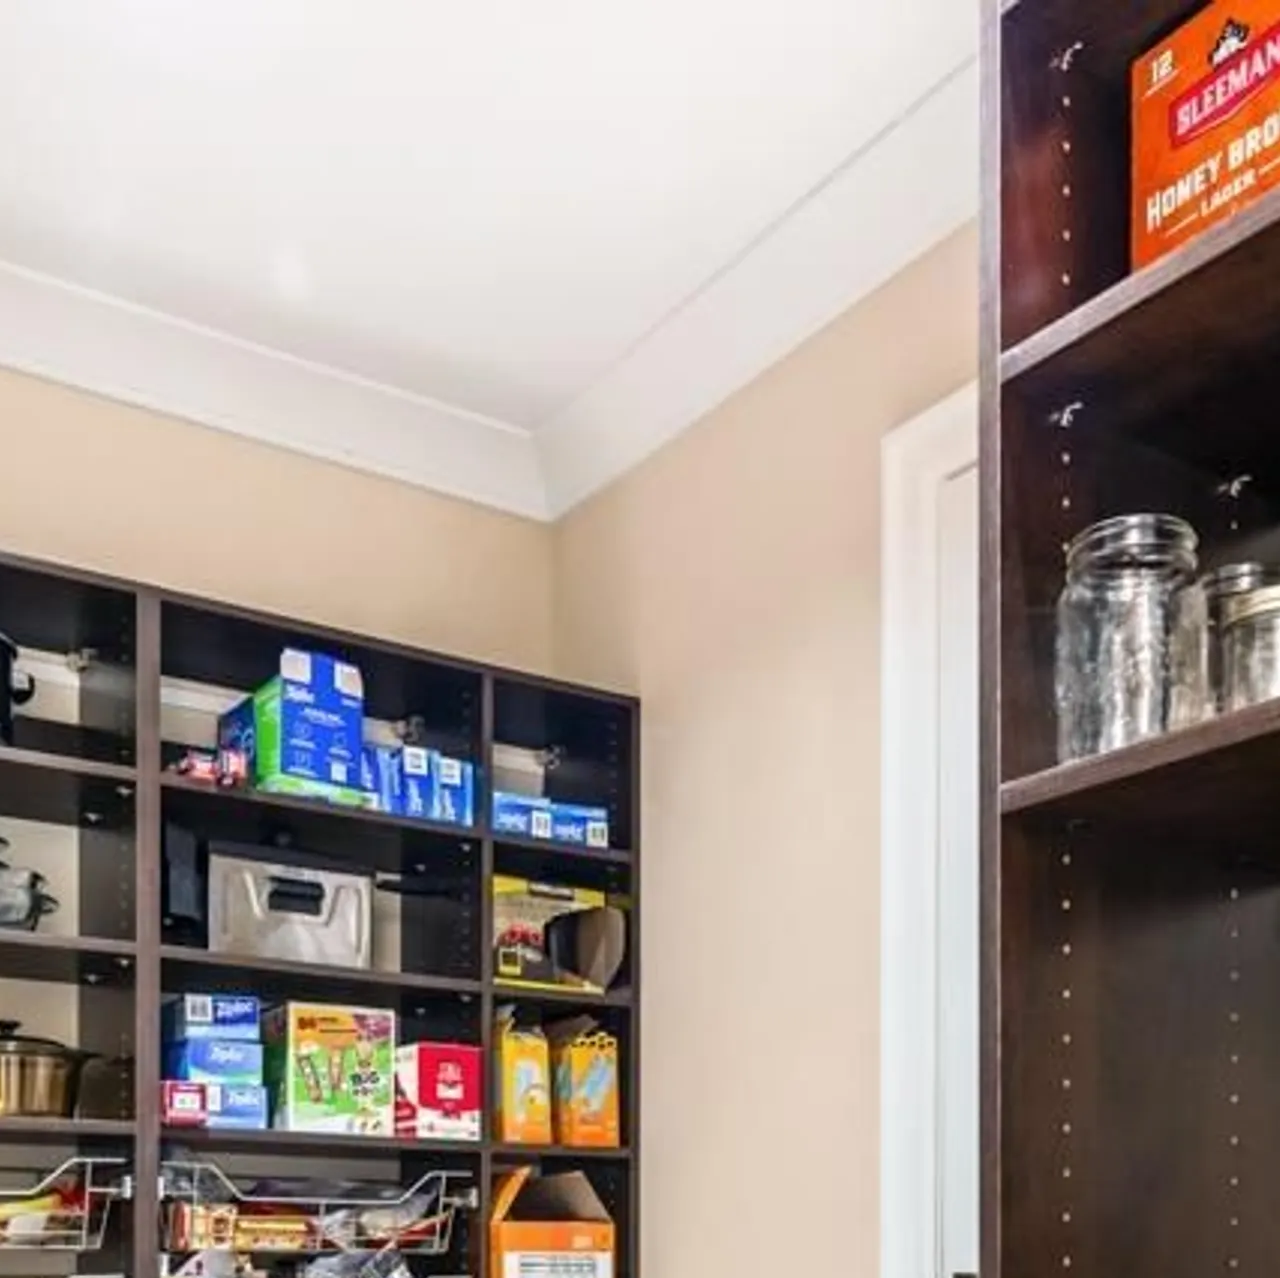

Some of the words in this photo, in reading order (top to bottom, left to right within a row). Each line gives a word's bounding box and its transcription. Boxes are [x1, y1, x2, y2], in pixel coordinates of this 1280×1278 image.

[1152, 49, 1173, 83] 12
[1146, 150, 1224, 231] HONEY
[1200, 168, 1257, 218] LAGER
